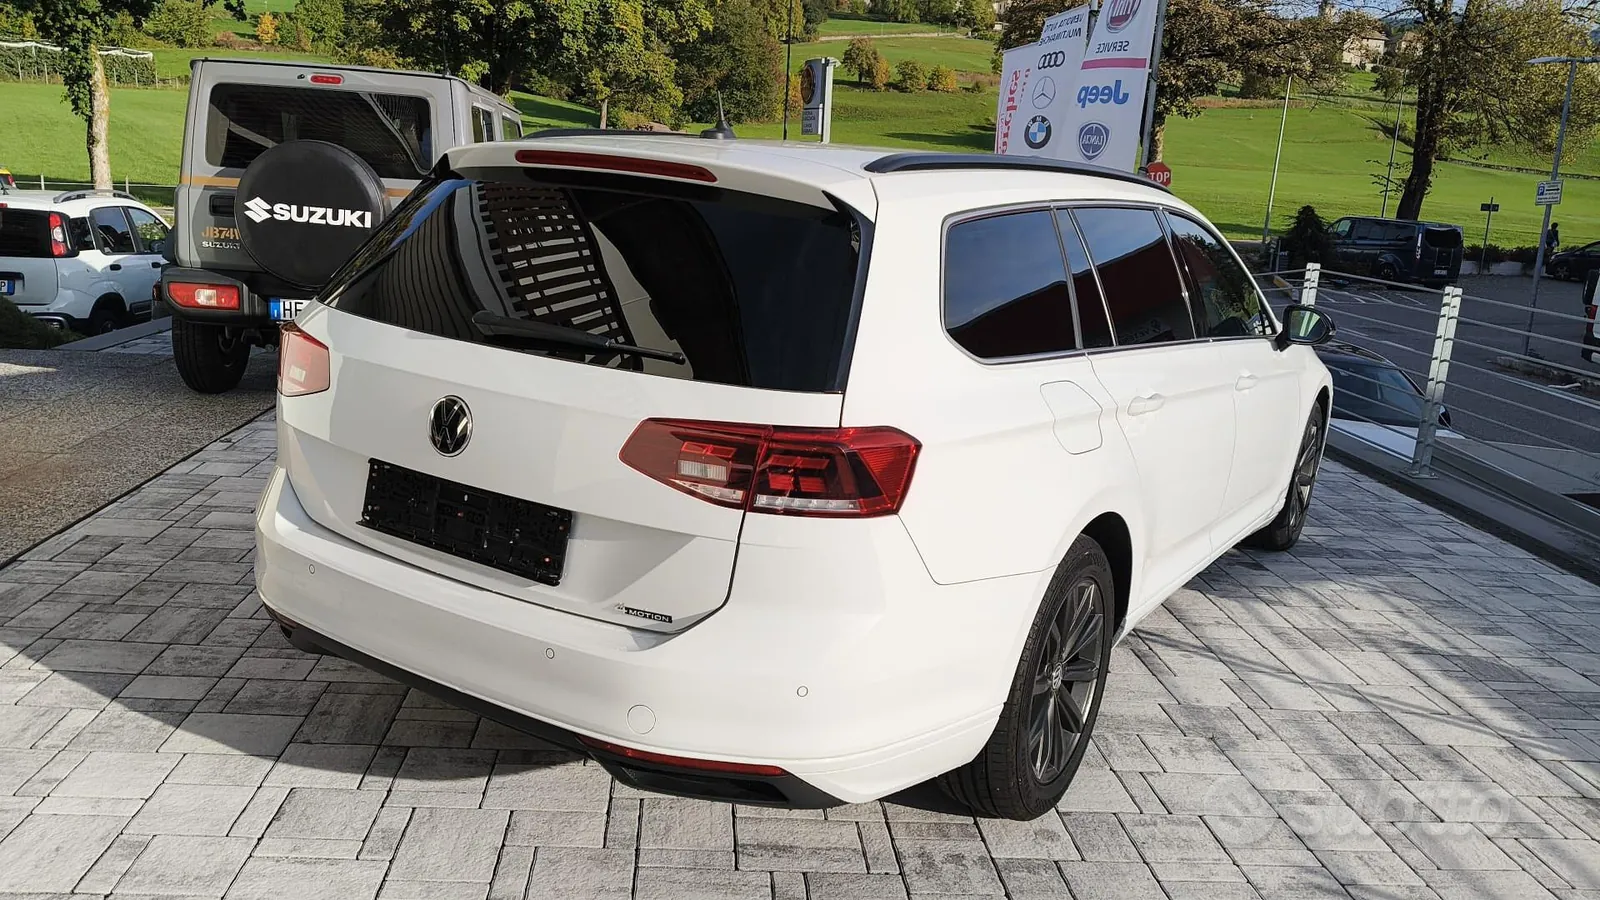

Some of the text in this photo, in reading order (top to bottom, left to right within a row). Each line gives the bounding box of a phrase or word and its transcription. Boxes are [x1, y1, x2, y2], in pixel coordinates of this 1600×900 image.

[1147, 171, 1170, 183] TOP
[272, 203, 372, 228] SUZUKI
[201, 240, 241, 250] SUZUKI
